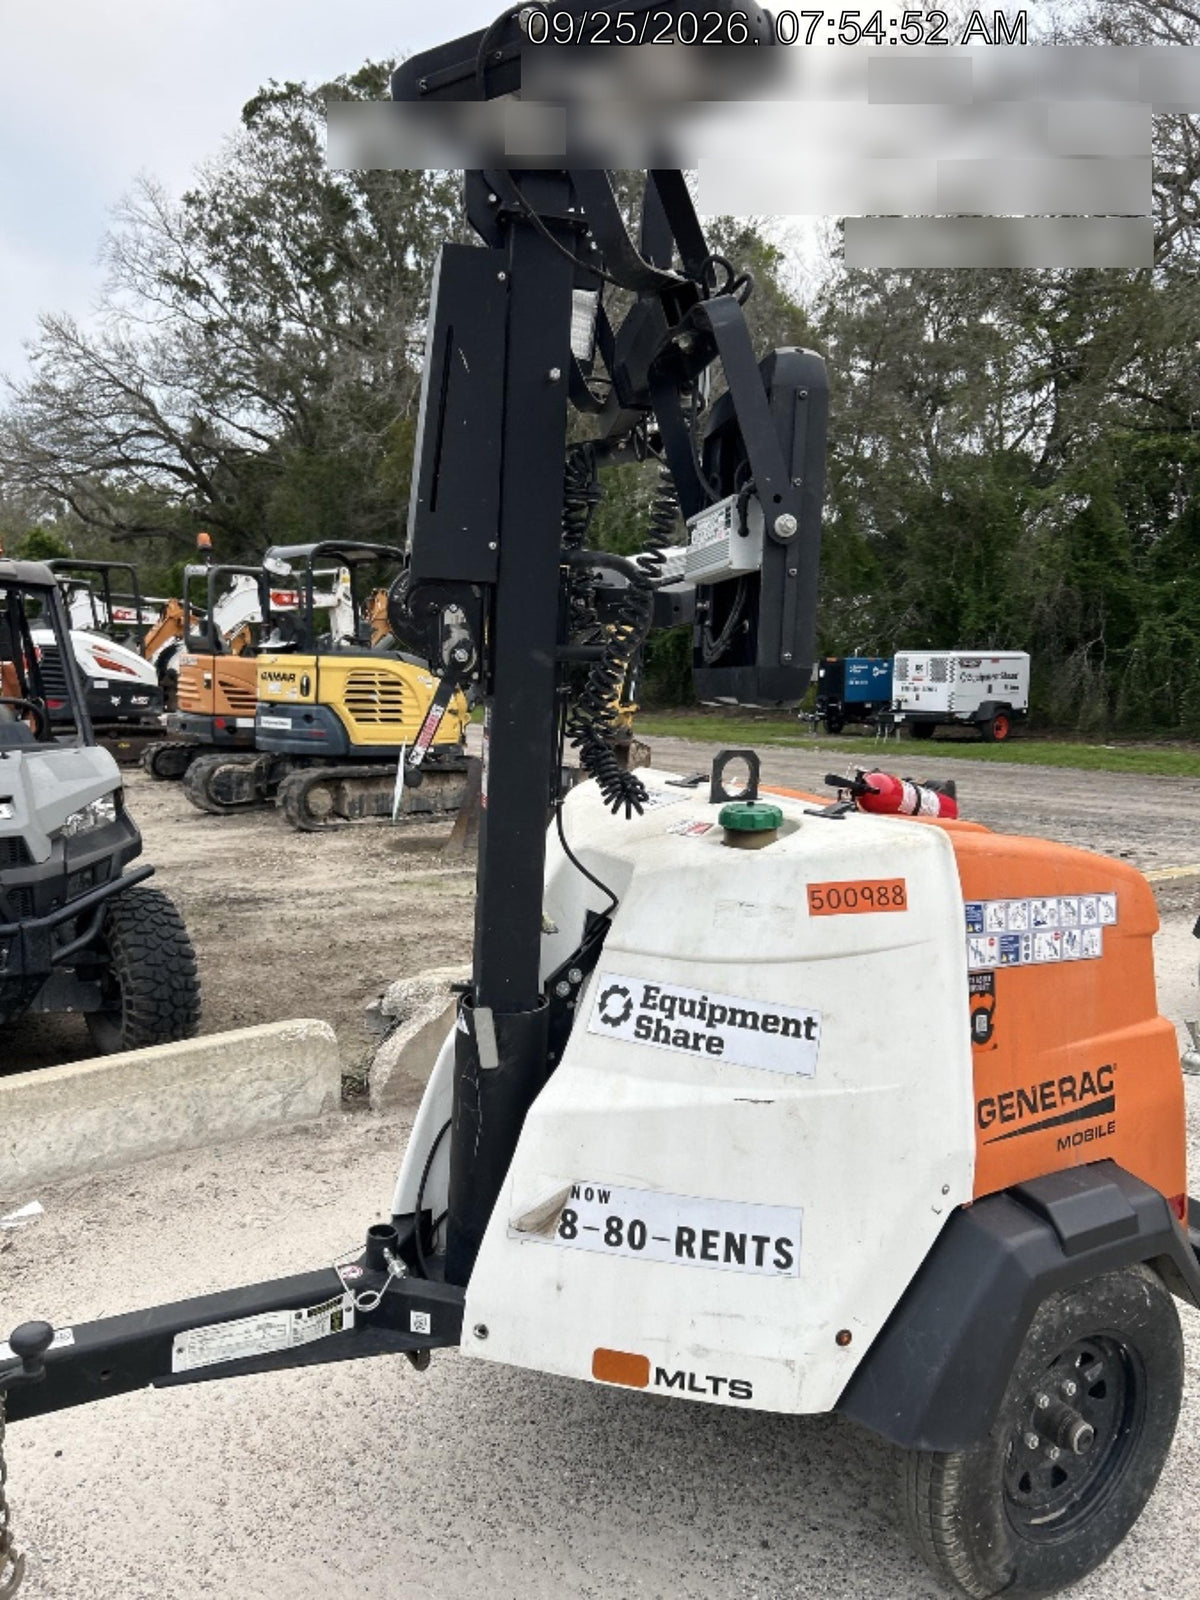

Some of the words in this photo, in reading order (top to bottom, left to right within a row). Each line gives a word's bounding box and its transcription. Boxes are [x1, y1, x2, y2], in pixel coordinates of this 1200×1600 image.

[810, 884, 904, 910] 500988
[639, 984, 818, 1041] Equipment
[633, 1014, 725, 1056] Share
[977, 1063, 1114, 1130] GENERAC
[1057, 1119, 1116, 1152] MOBILE
[570, 1185, 611, 1204] NOW
[654, 1366, 753, 1400] MLTS
